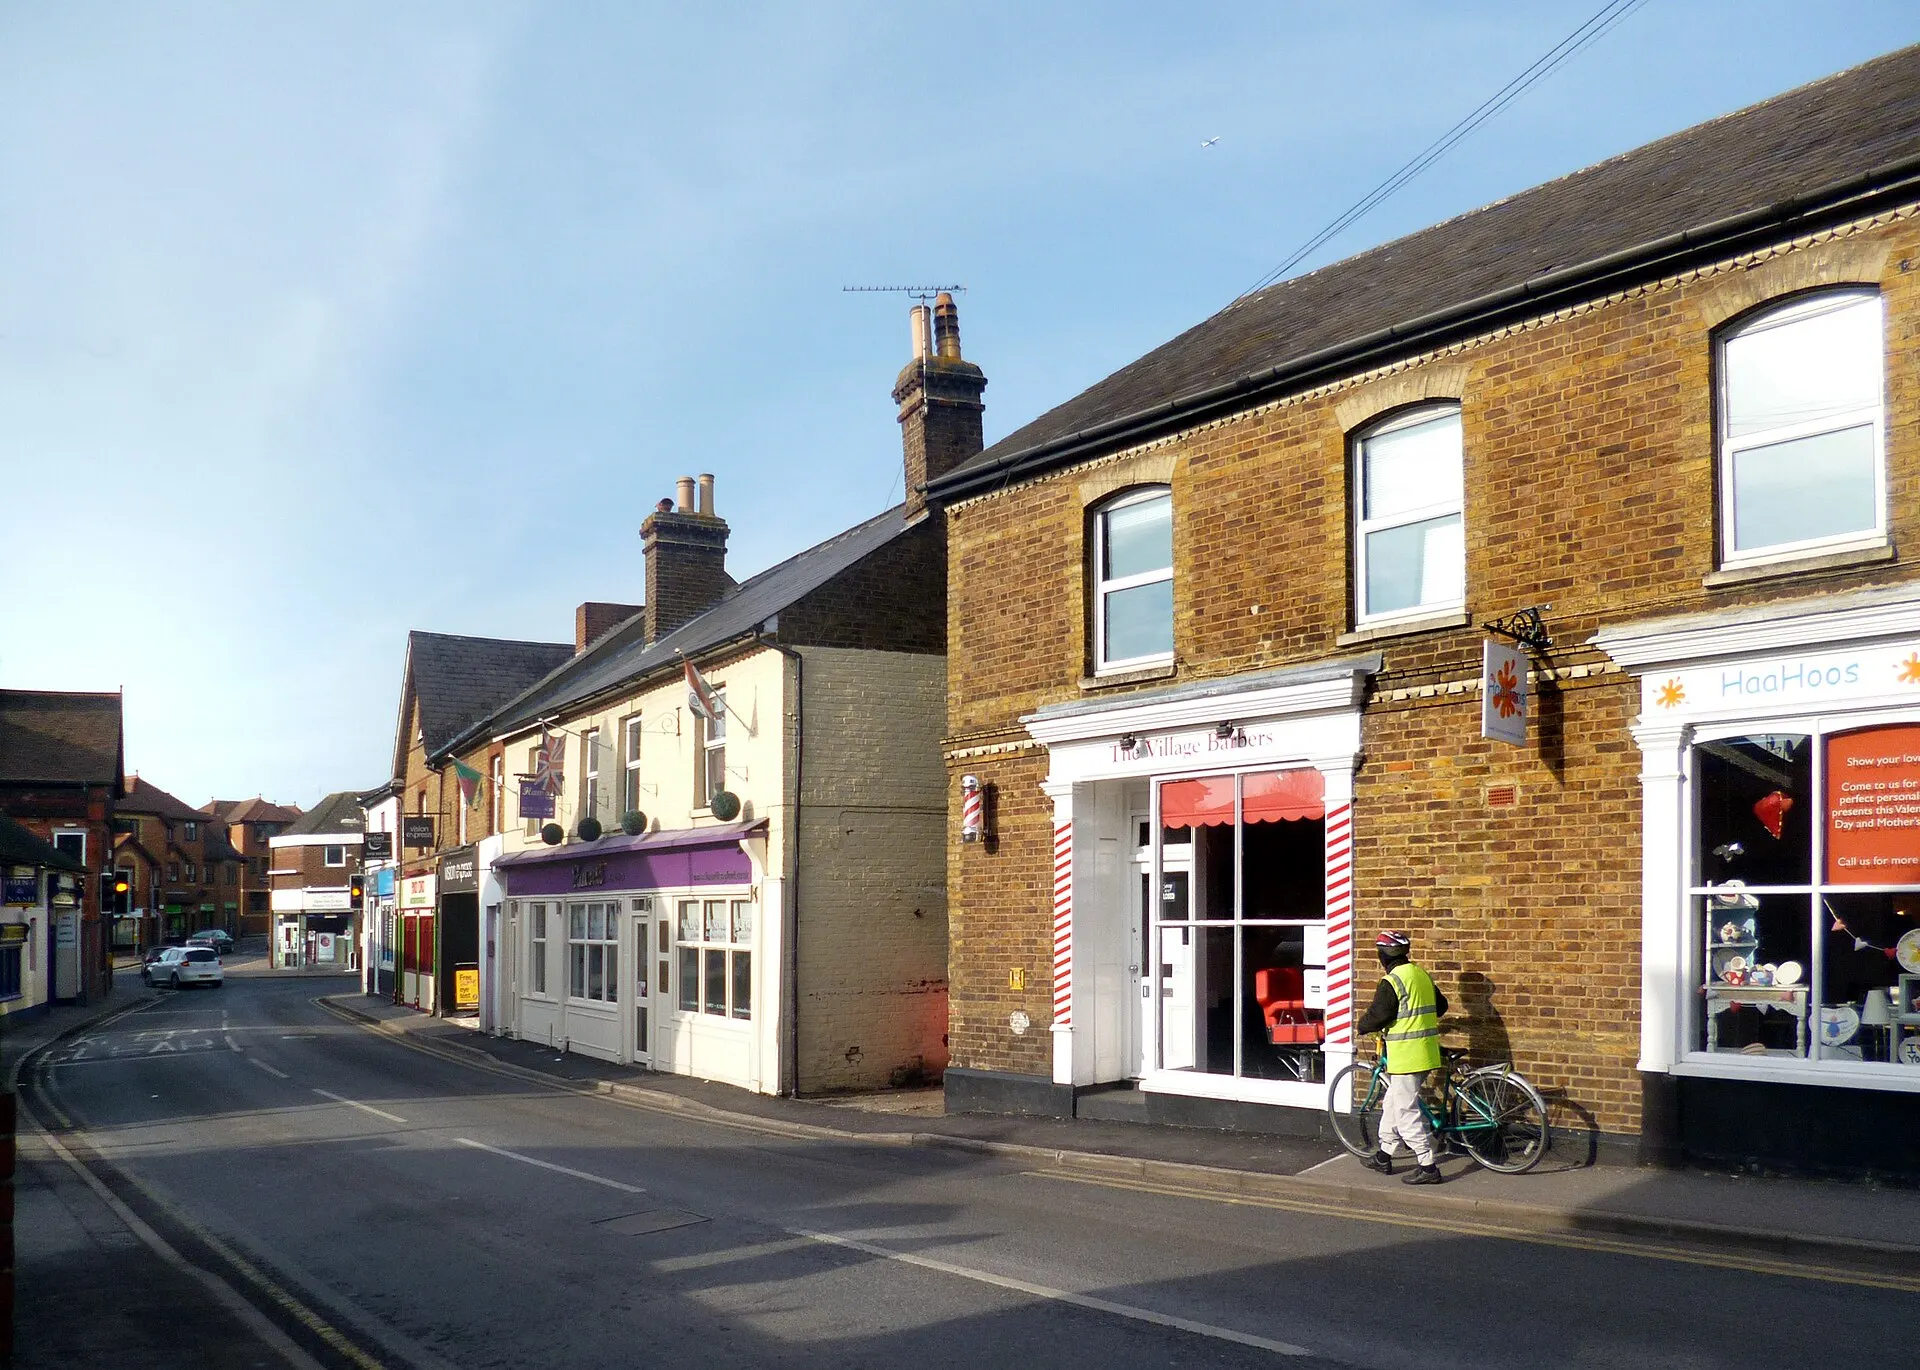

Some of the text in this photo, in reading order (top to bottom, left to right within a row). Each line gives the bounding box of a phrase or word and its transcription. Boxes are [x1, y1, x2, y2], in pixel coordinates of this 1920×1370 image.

[1722, 663, 1859, 697] HaaHoos
[1110, 729, 1274, 763] The Village Barbers
[1846, 757, 1875, 767] Show
[1876, 756, 1900, 767] your
[1841, 779, 1918, 792] Come to us for
[1839, 791, 1920, 806] perfect personal
[1831, 808, 1873, 819] presents
[1875, 806, 1894, 815] this
[409, 826, 430, 834] vision
[1834, 817, 1920, 830] Day and Mother's
[1837, 855, 1919, 867] Call us for more
[444, 862, 456, 882] vision
[459, 973, 472, 982] Free
[1906, 1043, 1917, 1054] I
